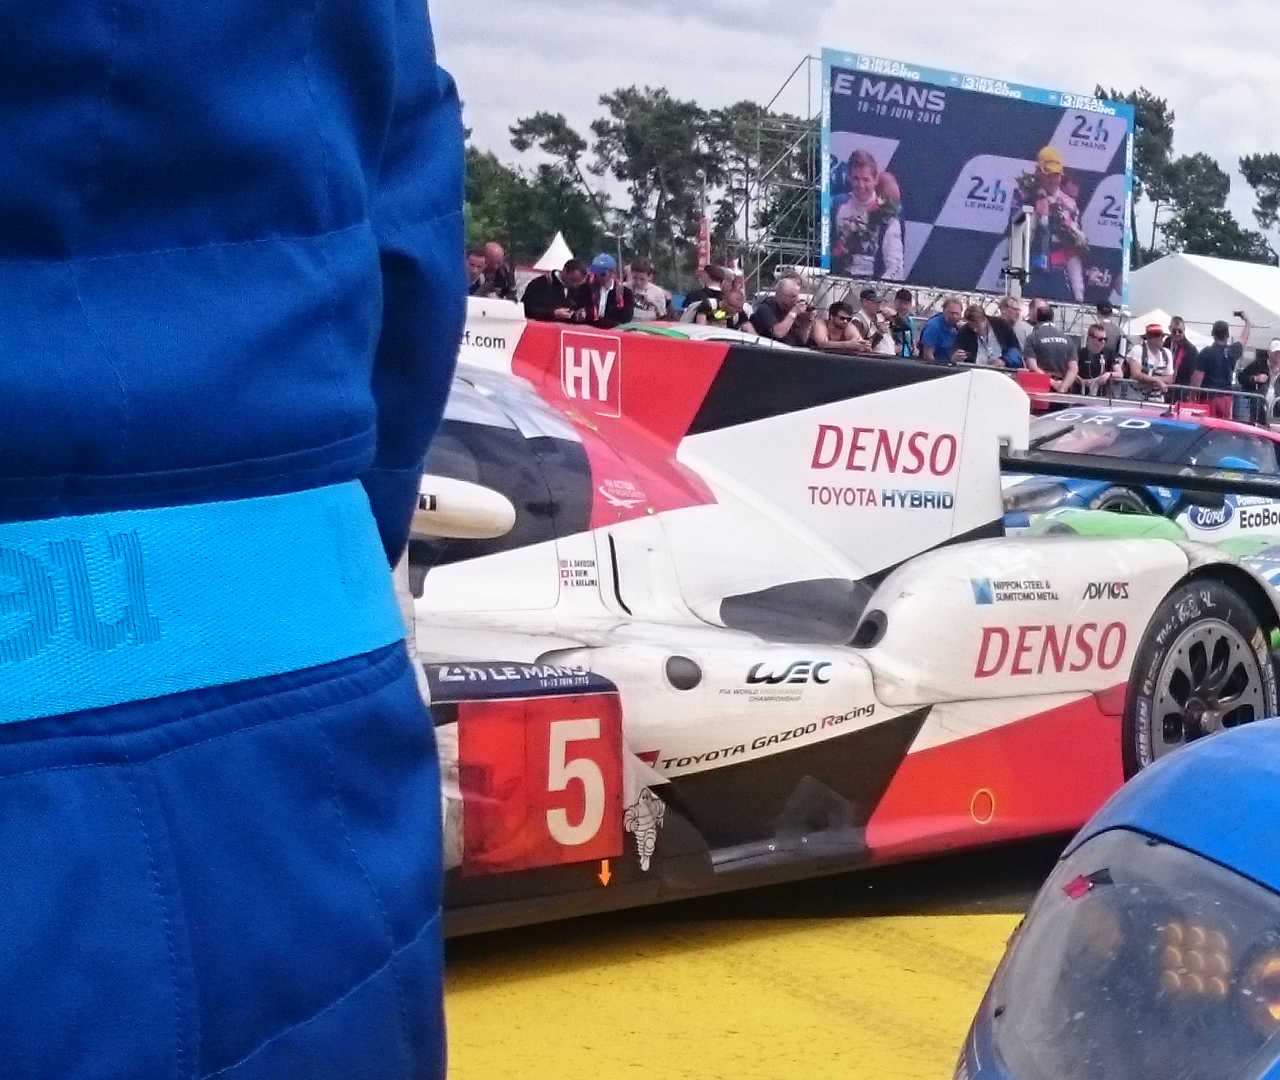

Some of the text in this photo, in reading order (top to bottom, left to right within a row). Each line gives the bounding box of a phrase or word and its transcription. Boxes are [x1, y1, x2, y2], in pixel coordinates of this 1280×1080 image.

[874, 65, 920, 79] RACING
[979, 77, 1009, 89] REAL
[834, 72, 855, 95] E
[859, 78, 946, 111] MANS
[978, 84, 1022, 98] RACING
[1075, 95, 1105, 107] REAL
[890, 107, 914, 121] JUIN
[917, 111, 942, 125] 2016
[1075, 102, 1117, 116] RACING
[1068, 138, 1107, 151] LE MANS
[977, 202, 1004, 212] MANS
[565, 347, 616, 401] HY
[1055, 413, 1152, 429] ORD
[811, 424, 957, 476] DENSO
[808, 486, 954, 510] TOYOTA HYBRID
[993, 581, 1022, 590] NIPPON
[1023, 581, 1045, 590] STEEL
[996, 591, 1059, 602] SUMITOMO METAL
[974, 621, 1127, 678] DENSO
[489, 667, 520, 680] LE
[746, 660, 833, 685] WEC
[662, 703, 876, 770] TOYOTA GAZOO Racing
[546, 717, 606, 846] 5
